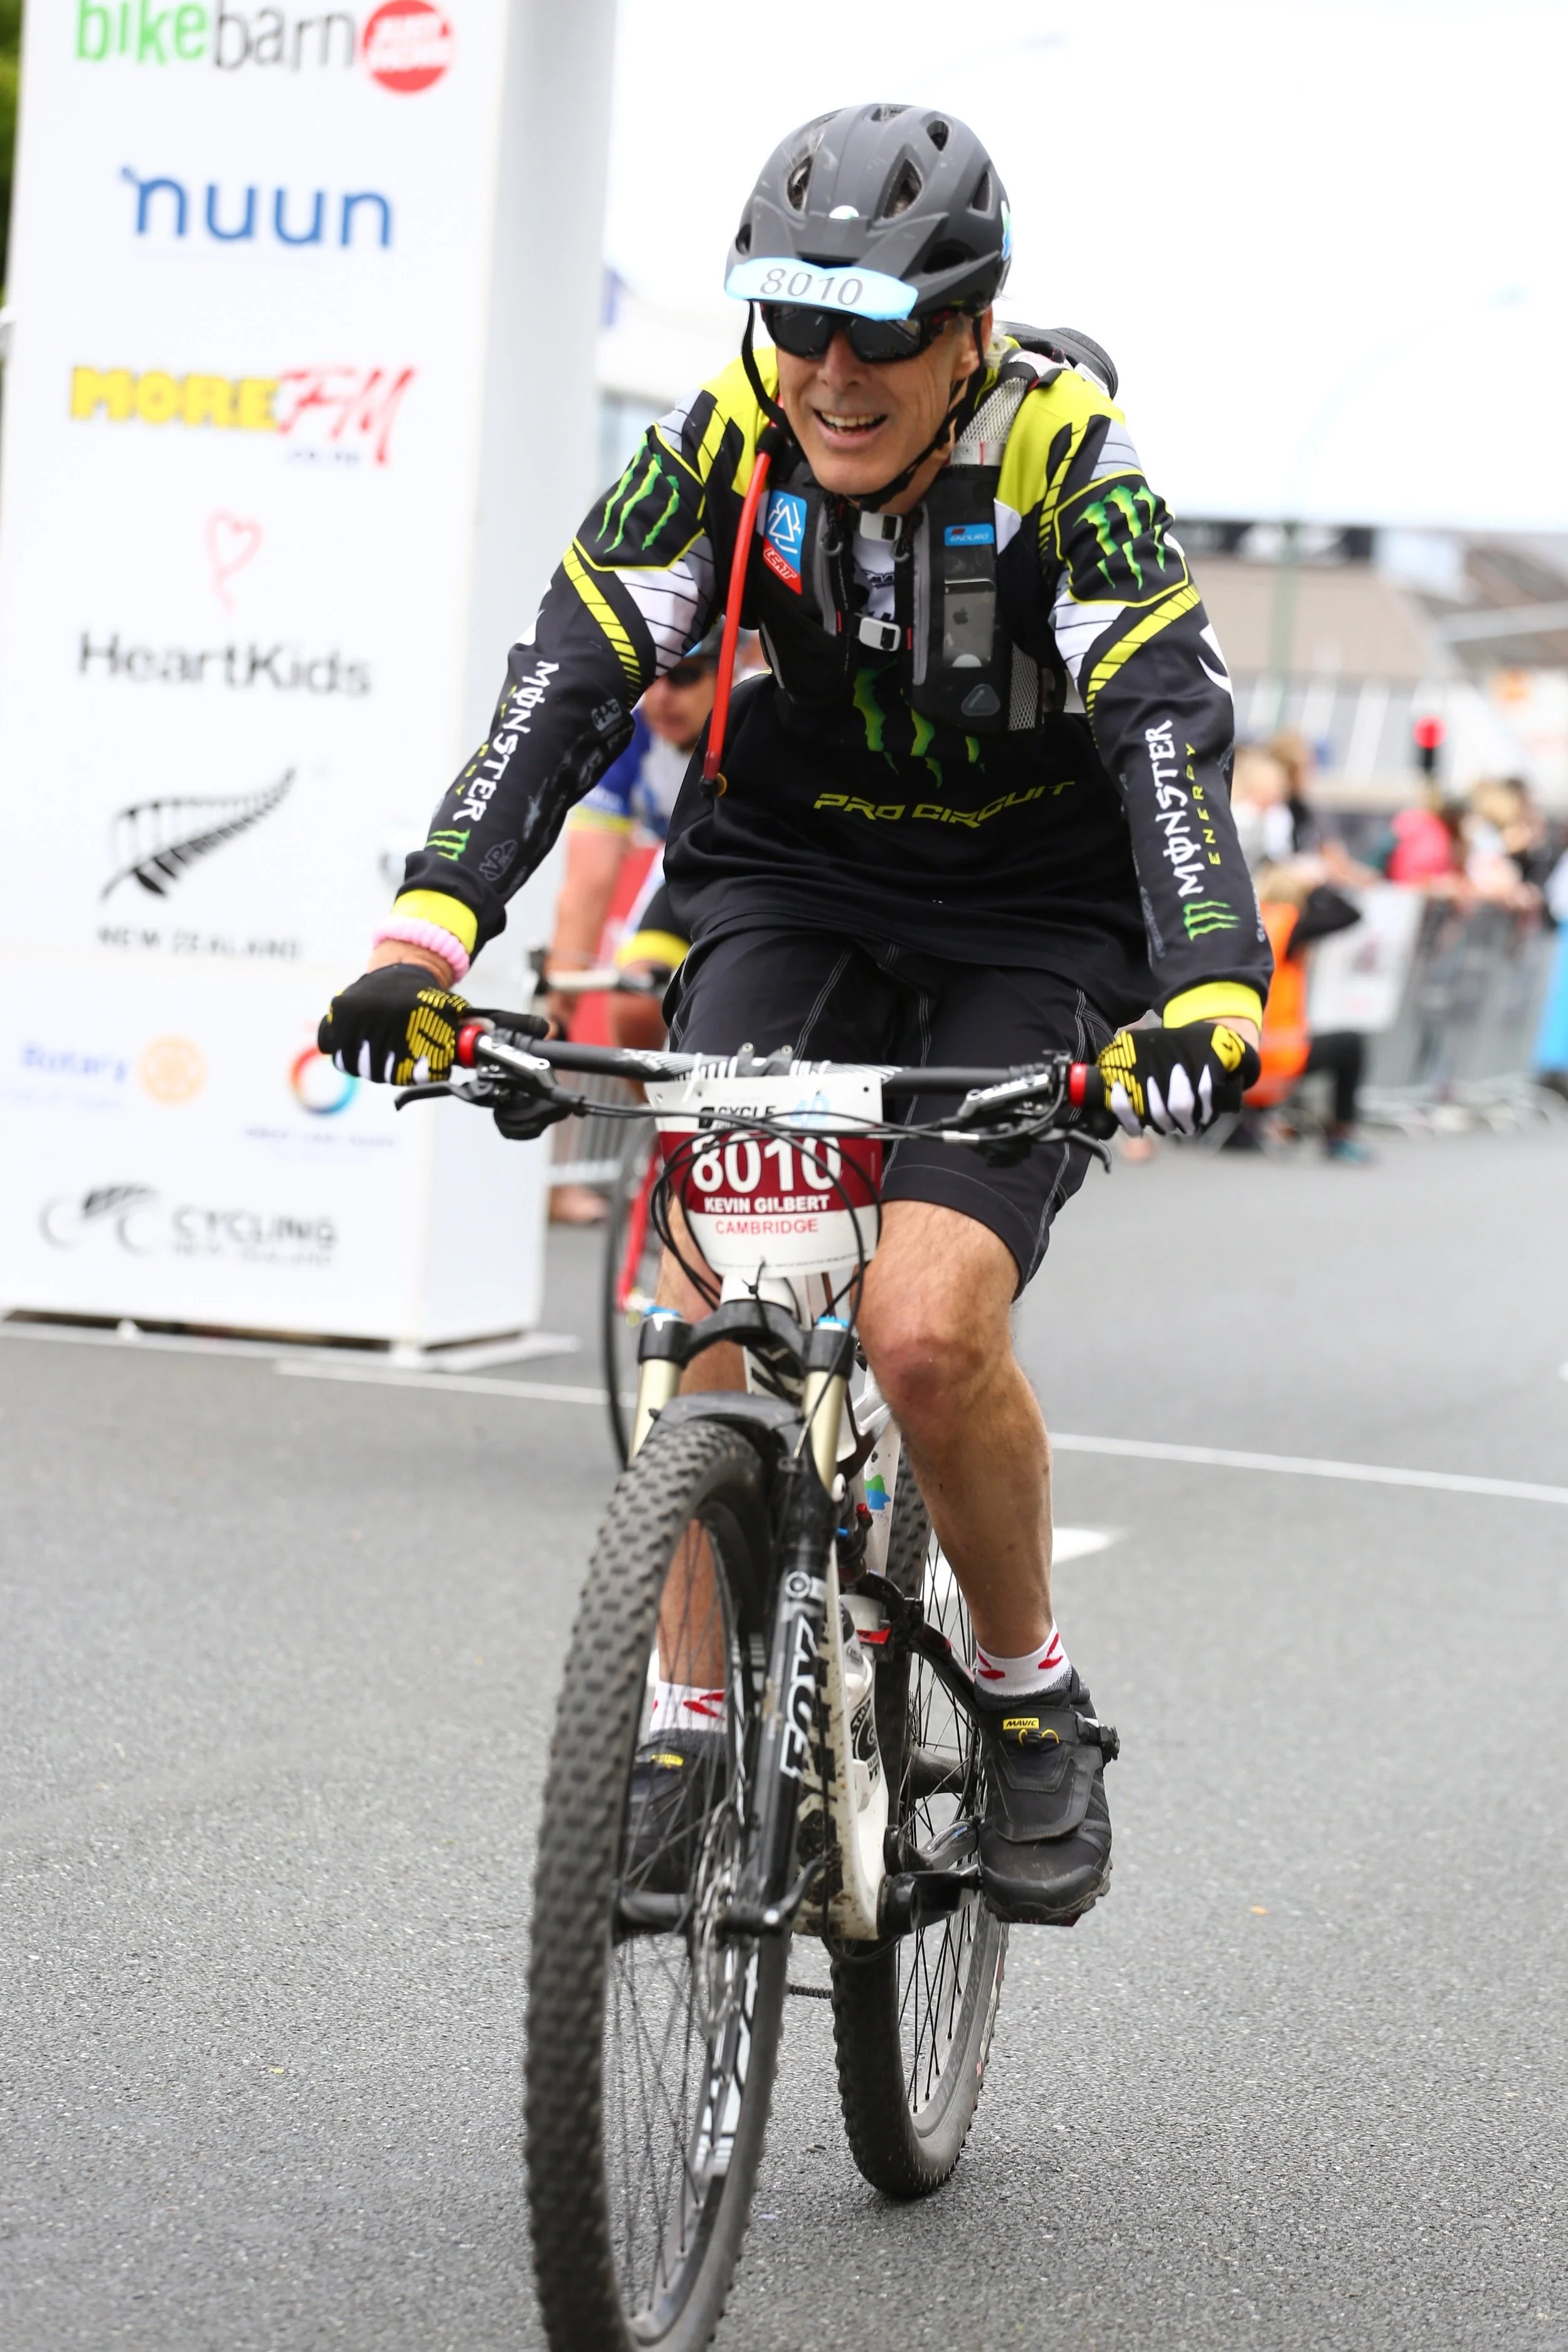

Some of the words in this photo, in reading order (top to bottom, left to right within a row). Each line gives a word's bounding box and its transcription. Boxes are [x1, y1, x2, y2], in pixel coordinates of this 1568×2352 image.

[121, 167, 393, 248] nuun
[759, 267, 864, 307] 8010
[763, 548, 798, 580] LEATT
[78, 632, 371, 696] HeartKids
[453, 660, 559, 822] MONSTER
[813, 793, 906, 820] PRO
[912, 781, 1075, 829] CIRCUIT
[1145, 720, 1209, 897] MONSTER
[1186, 744, 1221, 866] ENERGY
[691, 1132, 842, 1193] 8010
[704, 1196, 751, 1213] KEVIN
[754, 1194, 830, 1213] GILBERT
[715, 1217, 818, 1236] CAMBRIDGE
[1005, 1720, 1038, 1728] MAVIC
